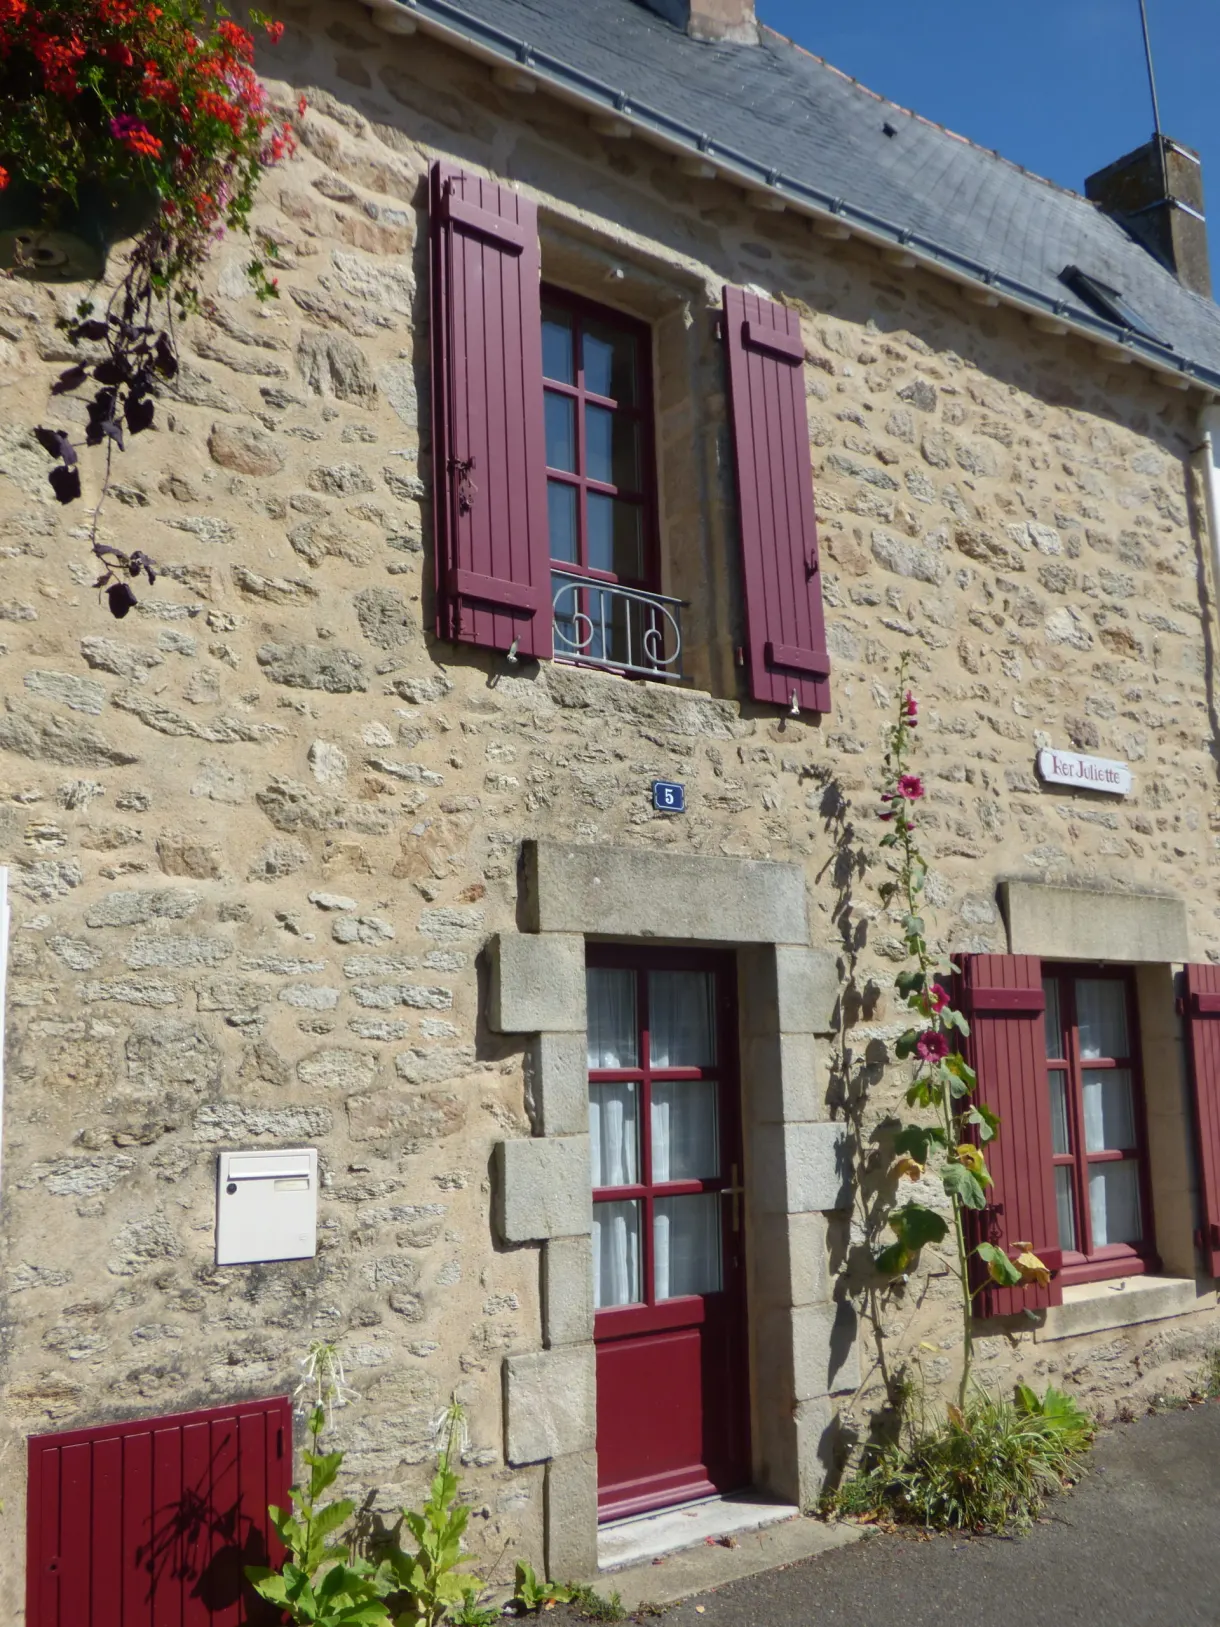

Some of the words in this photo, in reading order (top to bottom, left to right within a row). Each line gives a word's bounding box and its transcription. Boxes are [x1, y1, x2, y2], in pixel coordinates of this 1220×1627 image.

[1052, 755, 1075, 777] Ker
[1076, 760, 1121, 784] Juliette
[664, 787, 674, 805] 5
